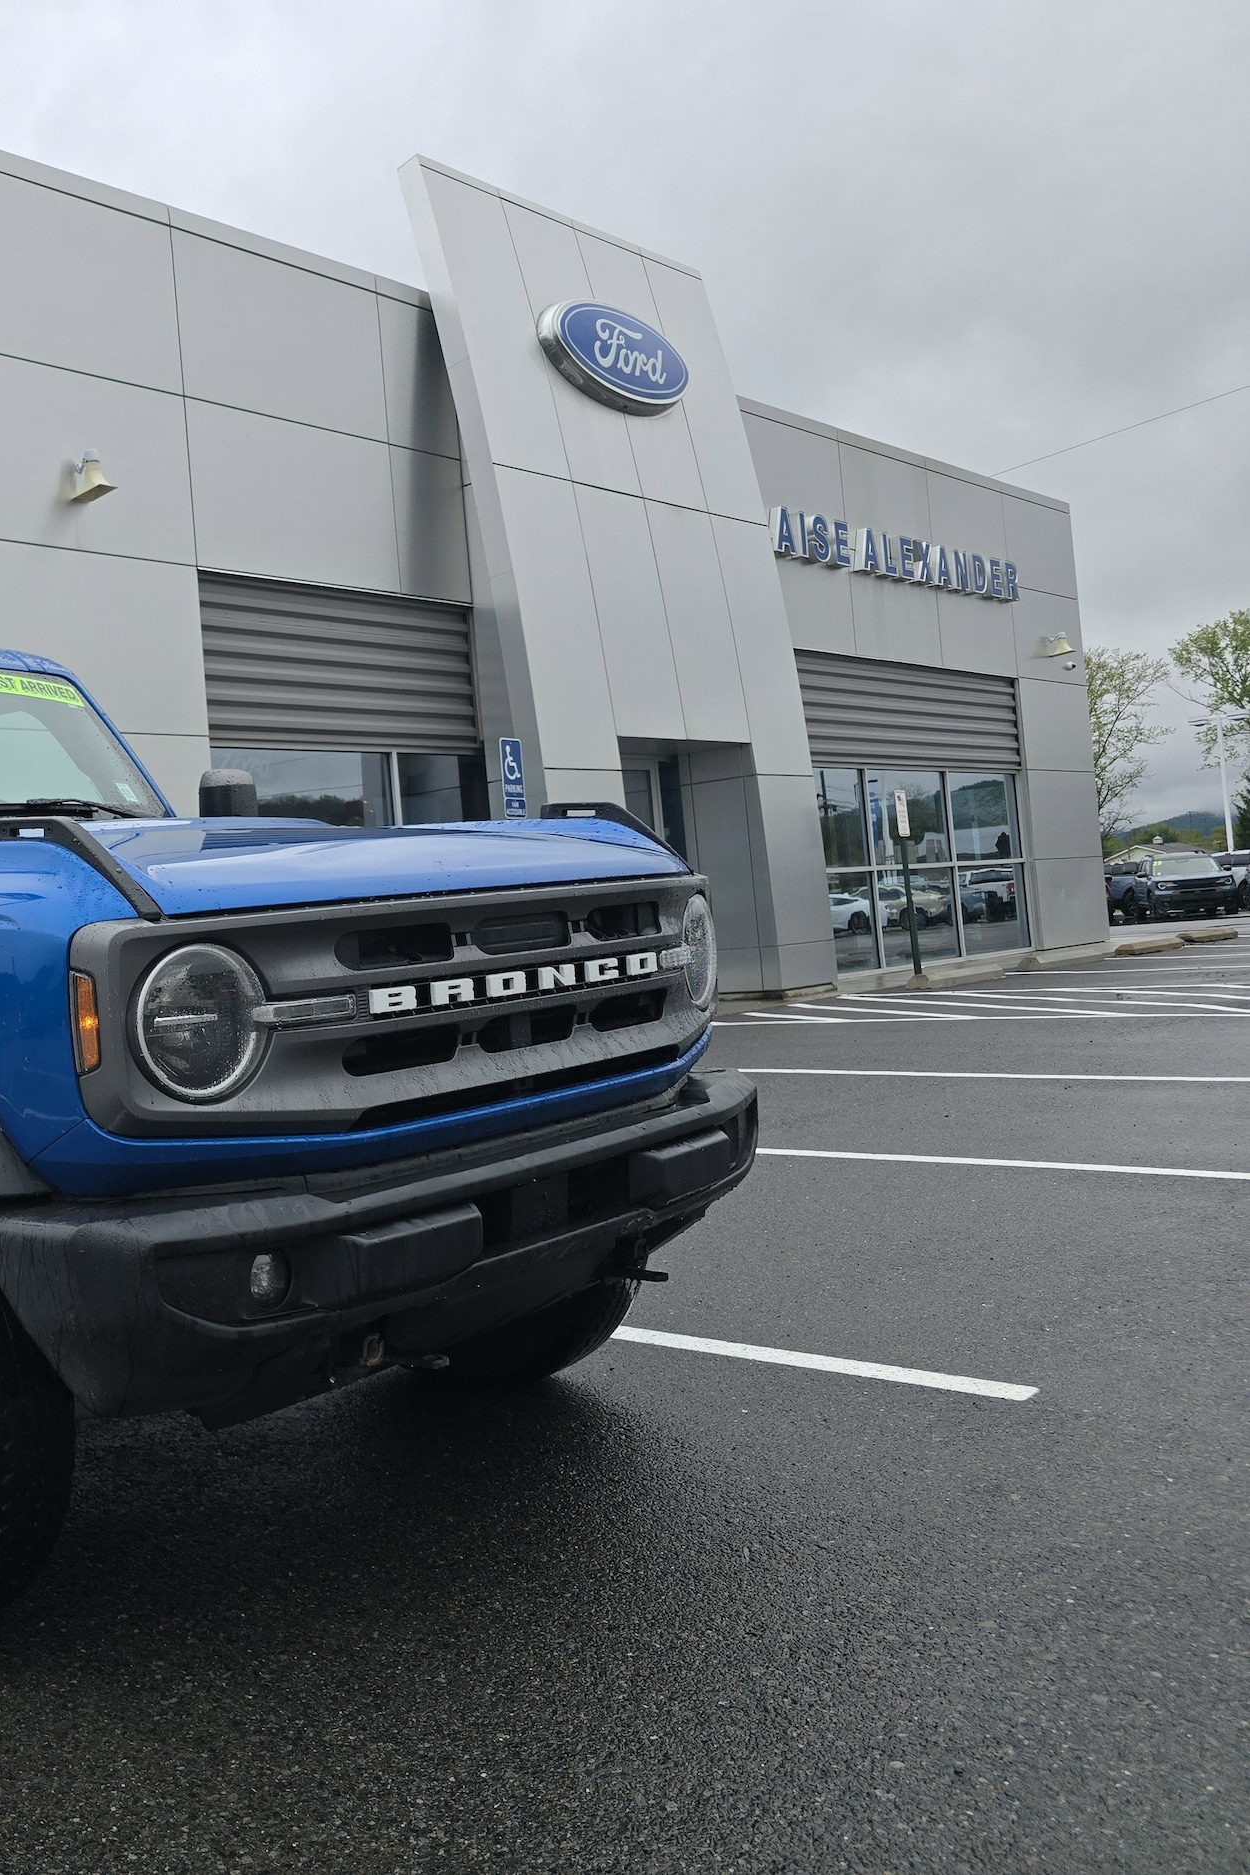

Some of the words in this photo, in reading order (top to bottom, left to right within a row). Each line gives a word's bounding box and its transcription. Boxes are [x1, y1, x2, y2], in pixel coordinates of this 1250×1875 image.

[594, 318, 666, 385] Ford
[770, 505, 851, 567] AISE
[854, 527, 1020, 601] ALEXANDER
[20, 680, 78, 701] ARRIVED
[504, 784, 523, 793] PARKING
[368, 951, 658, 1015] BRONCO
